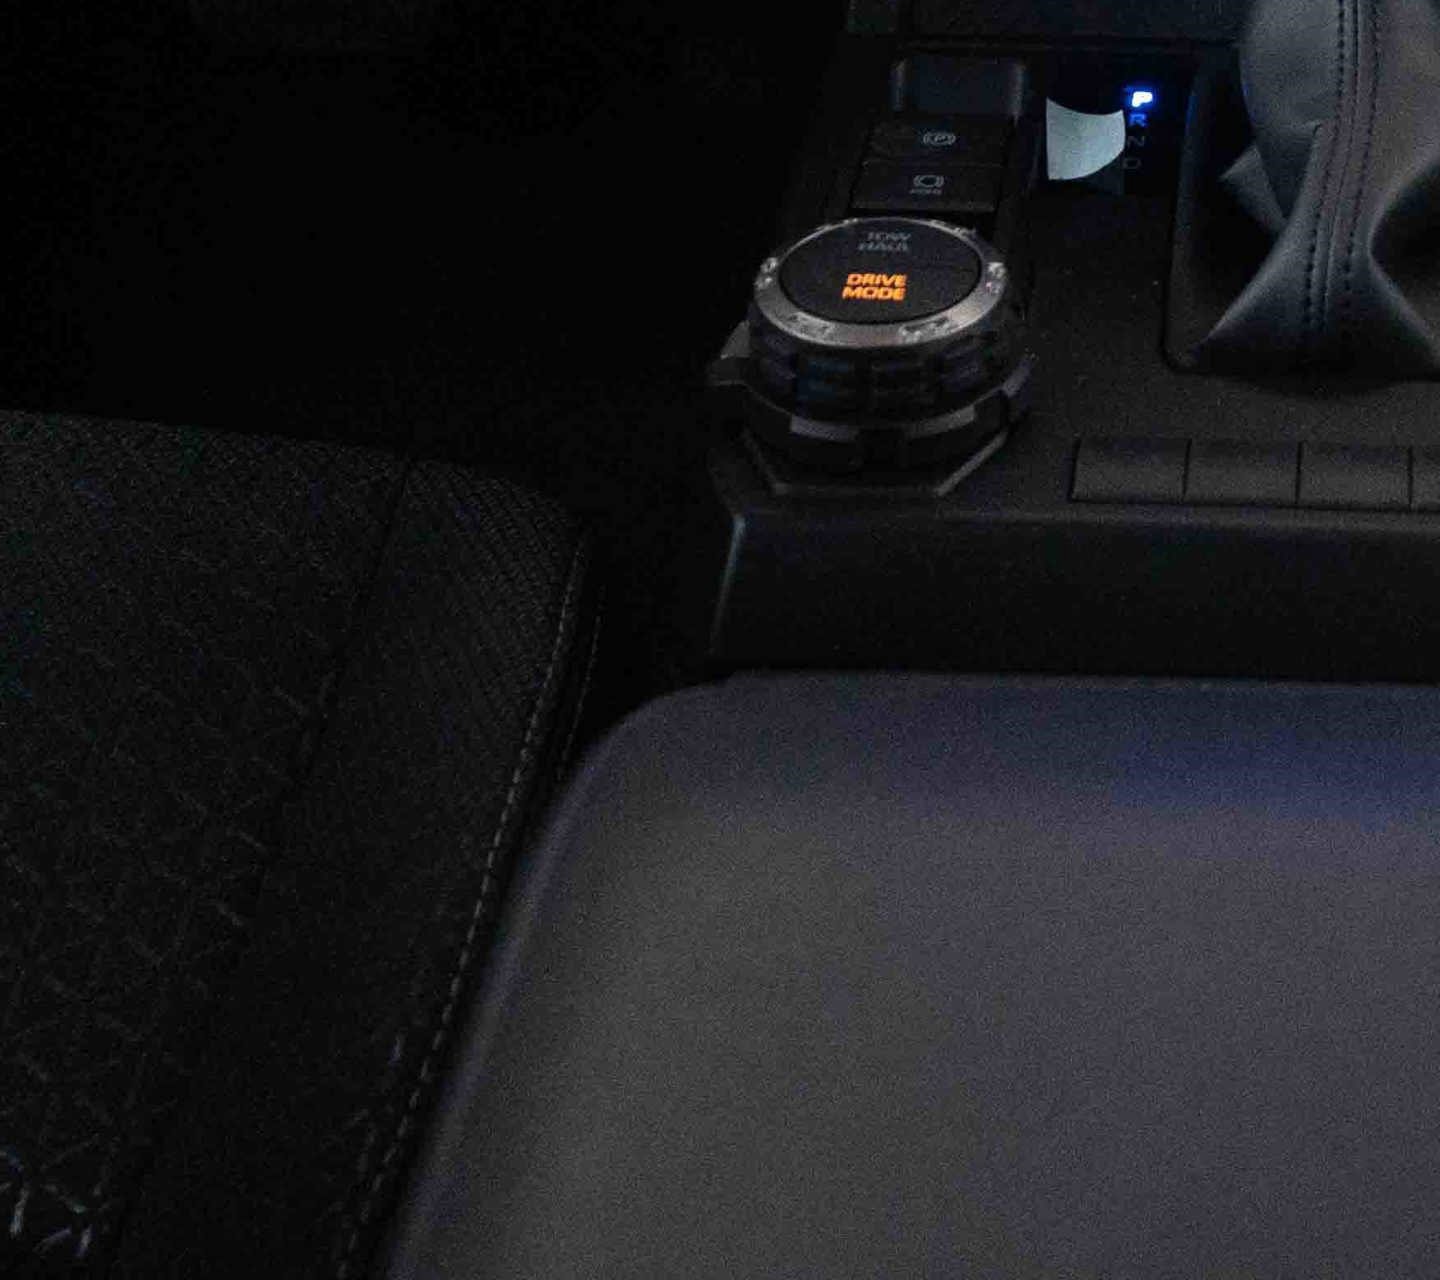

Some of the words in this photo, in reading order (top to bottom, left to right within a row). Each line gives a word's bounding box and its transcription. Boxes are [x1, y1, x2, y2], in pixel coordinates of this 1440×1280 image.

[1130, 90, 1154, 109] P
[846, 272, 909, 287] DRIVE
[841, 287, 907, 301] MODE
